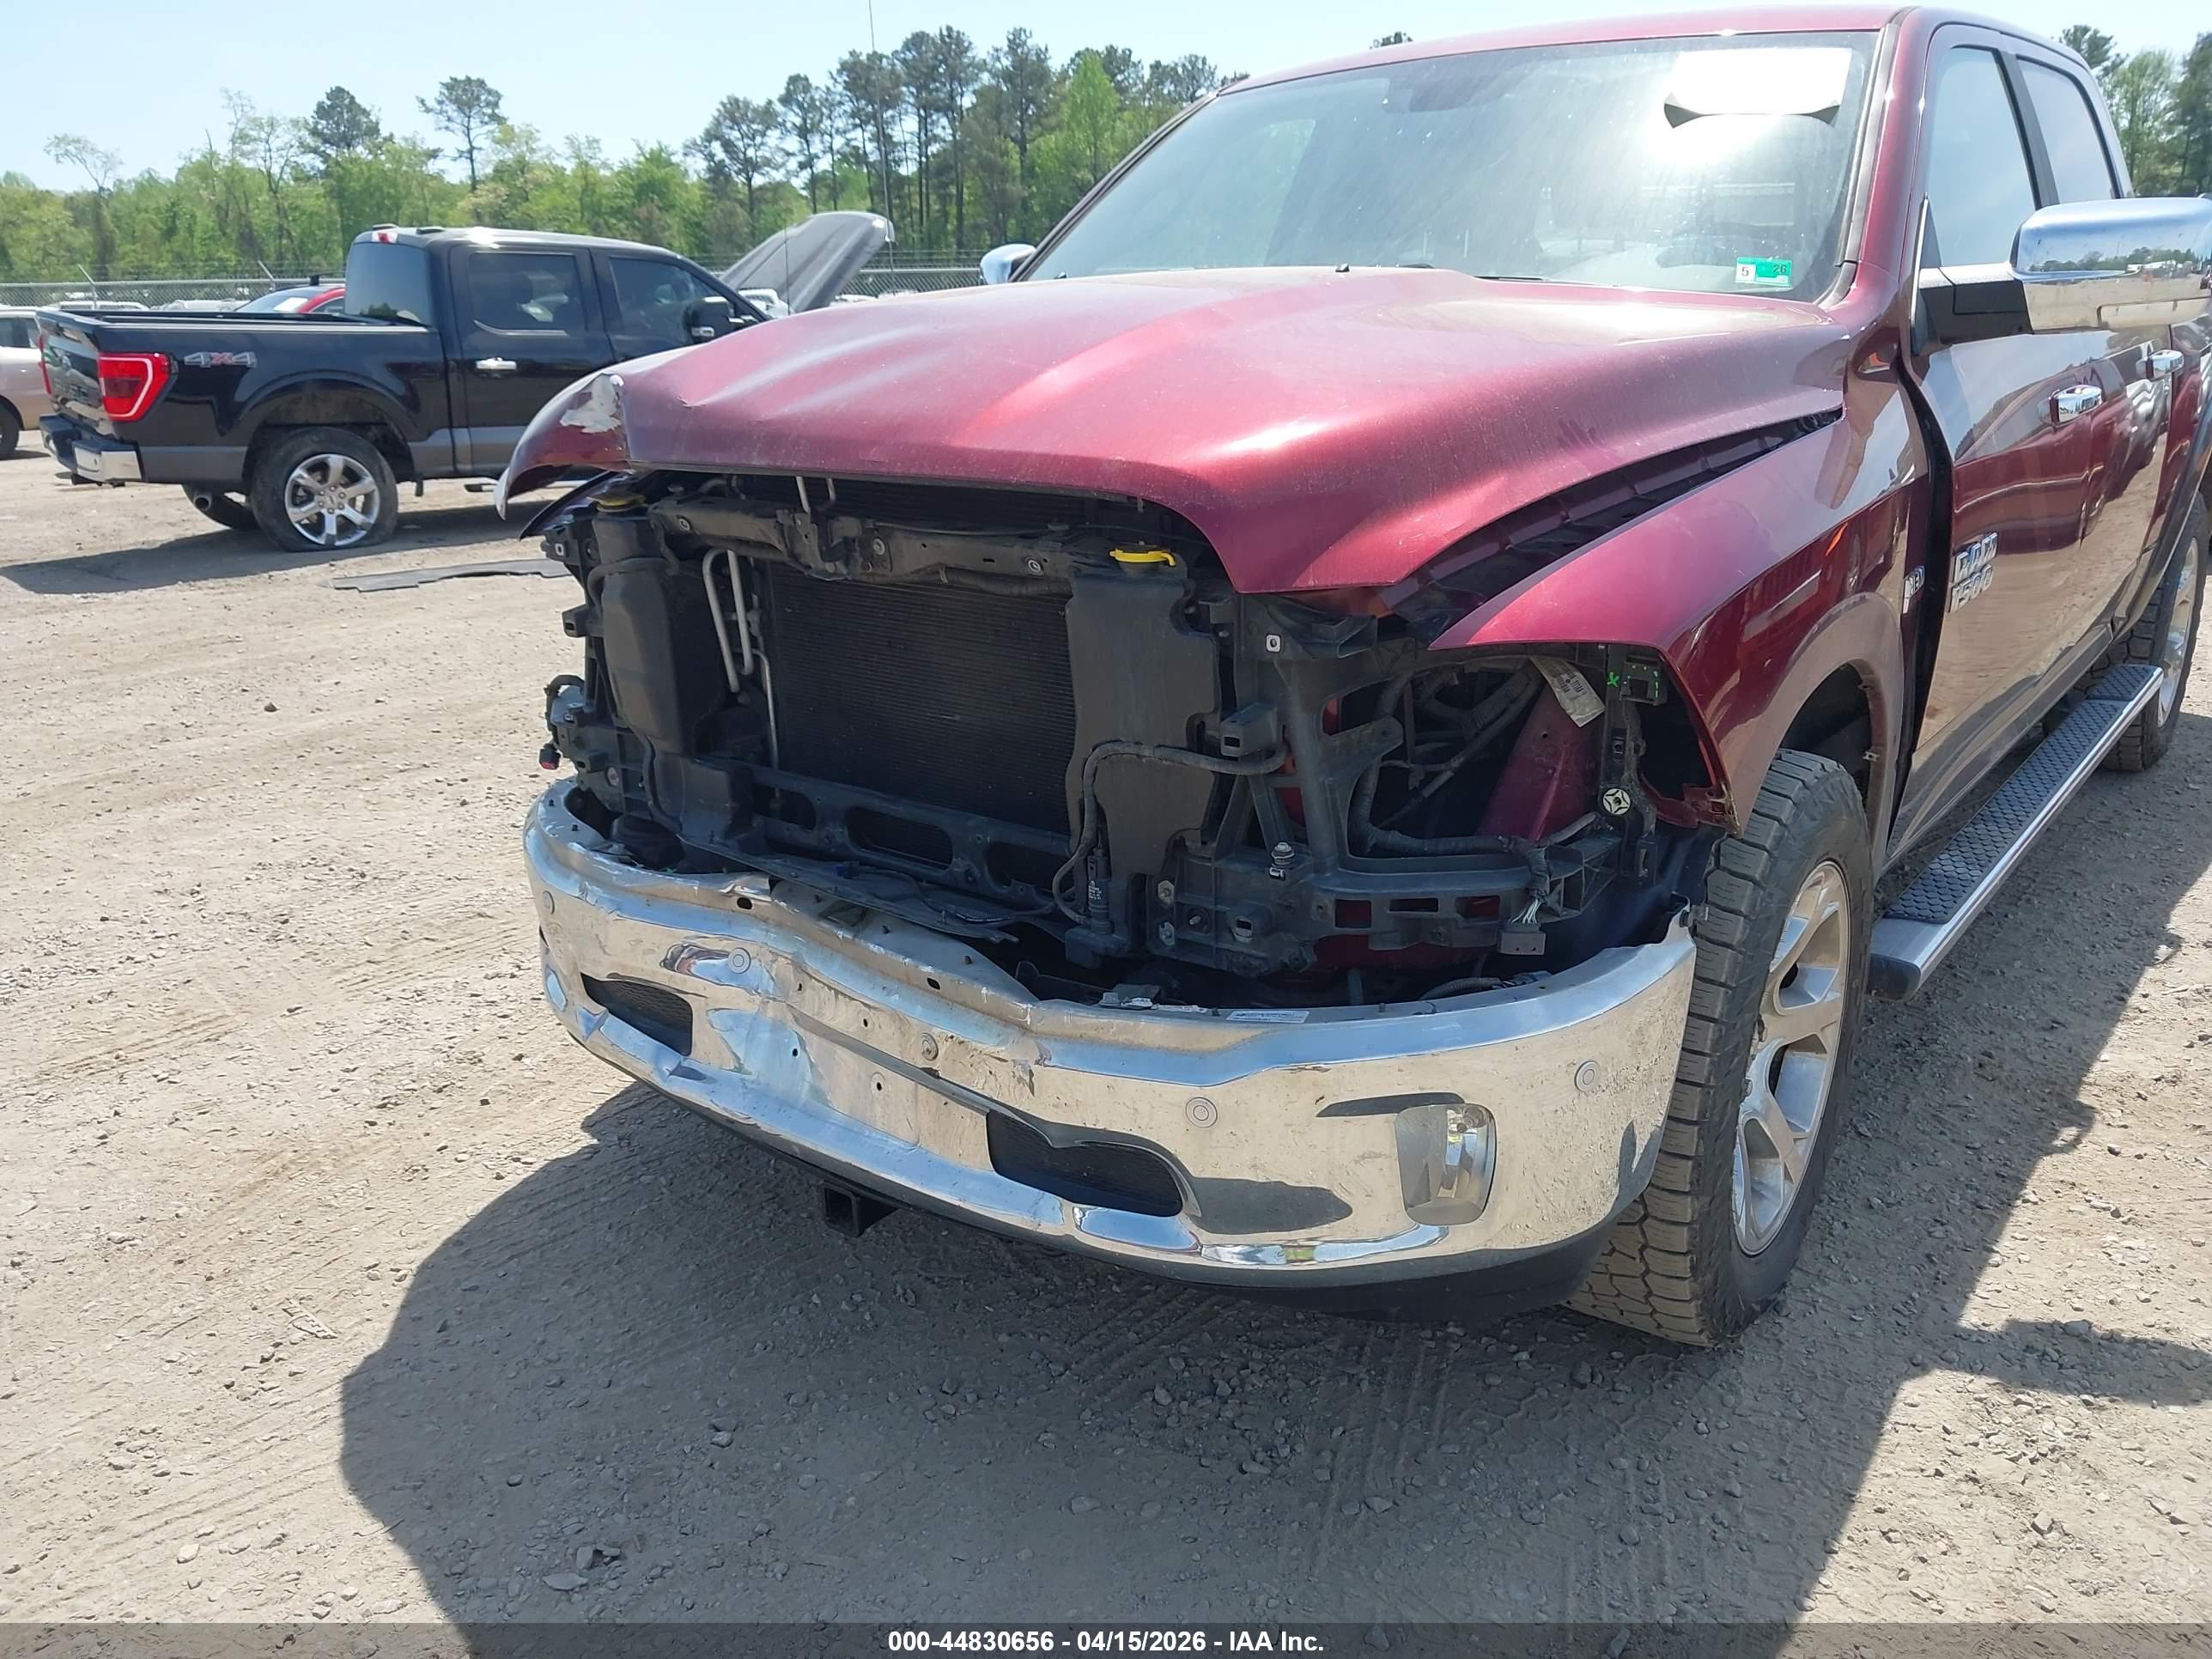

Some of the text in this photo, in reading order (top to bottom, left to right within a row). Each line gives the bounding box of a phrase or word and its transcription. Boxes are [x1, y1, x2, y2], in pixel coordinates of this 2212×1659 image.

[1741, 266, 1750, 277] 5
[1772, 264, 1788, 274] 26
[1953, 532, 1998, 585] RAM
[1949, 563, 1993, 613] 1500
